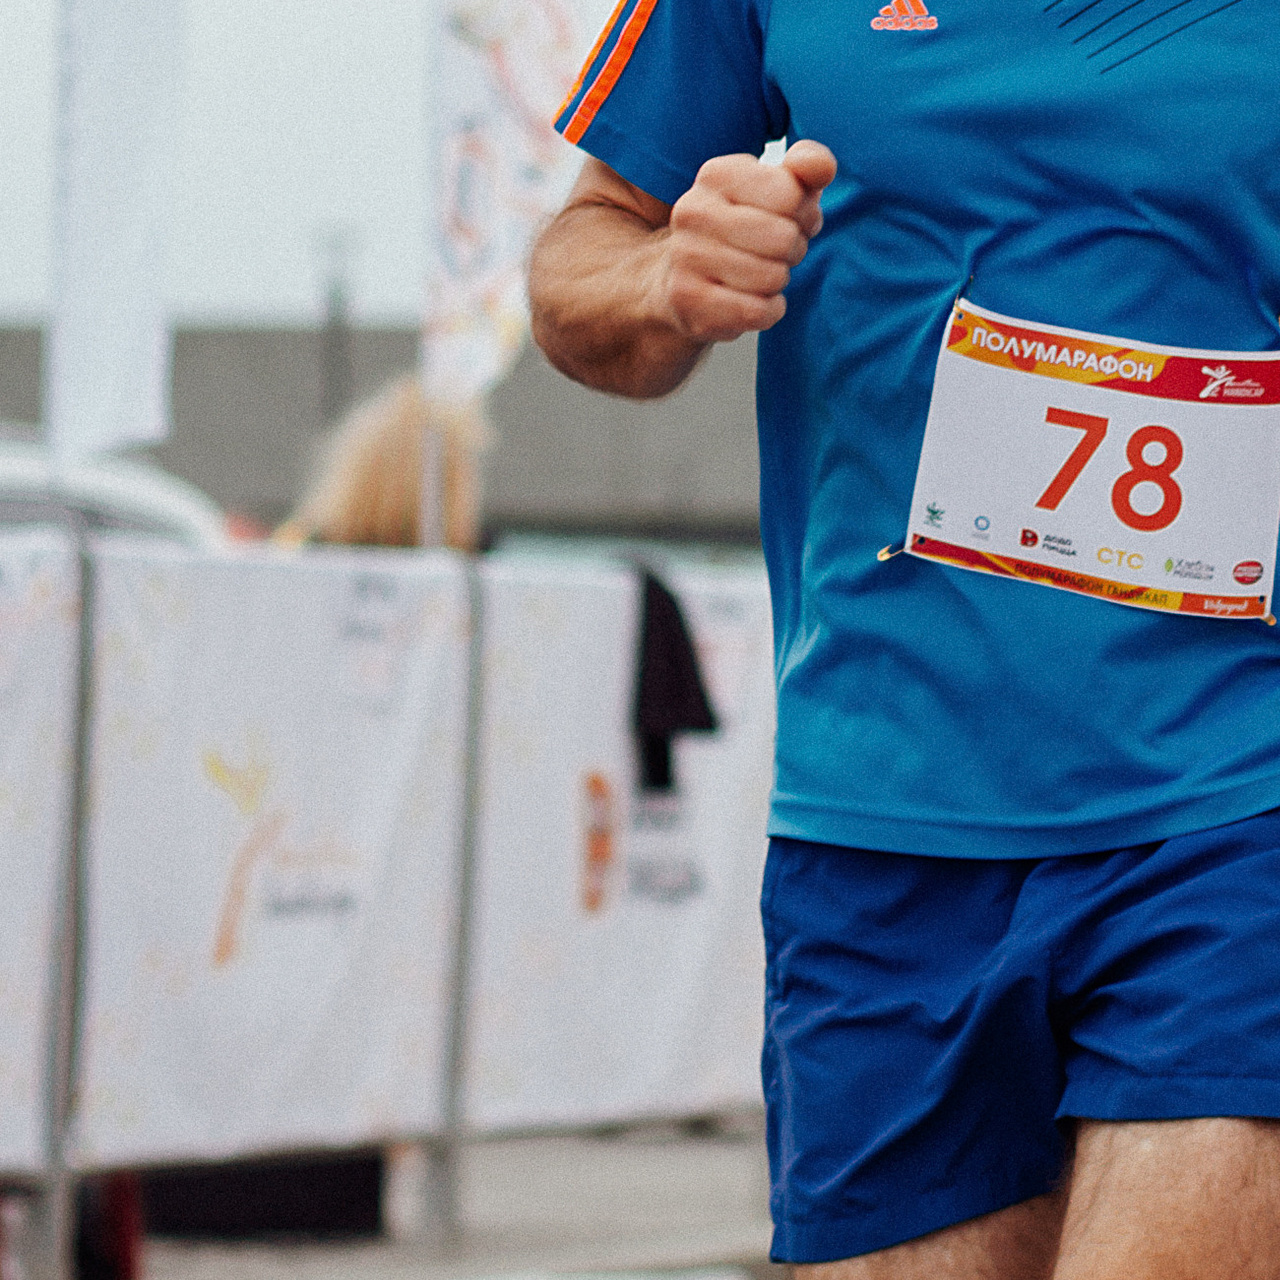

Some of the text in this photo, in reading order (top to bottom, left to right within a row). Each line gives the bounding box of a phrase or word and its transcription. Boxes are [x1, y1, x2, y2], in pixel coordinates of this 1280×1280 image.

[870, 14, 939, 32] adidas
[972, 326, 1155, 383] ПОЛУМАРАФОН
[1034, 406, 1184, 532] 78
